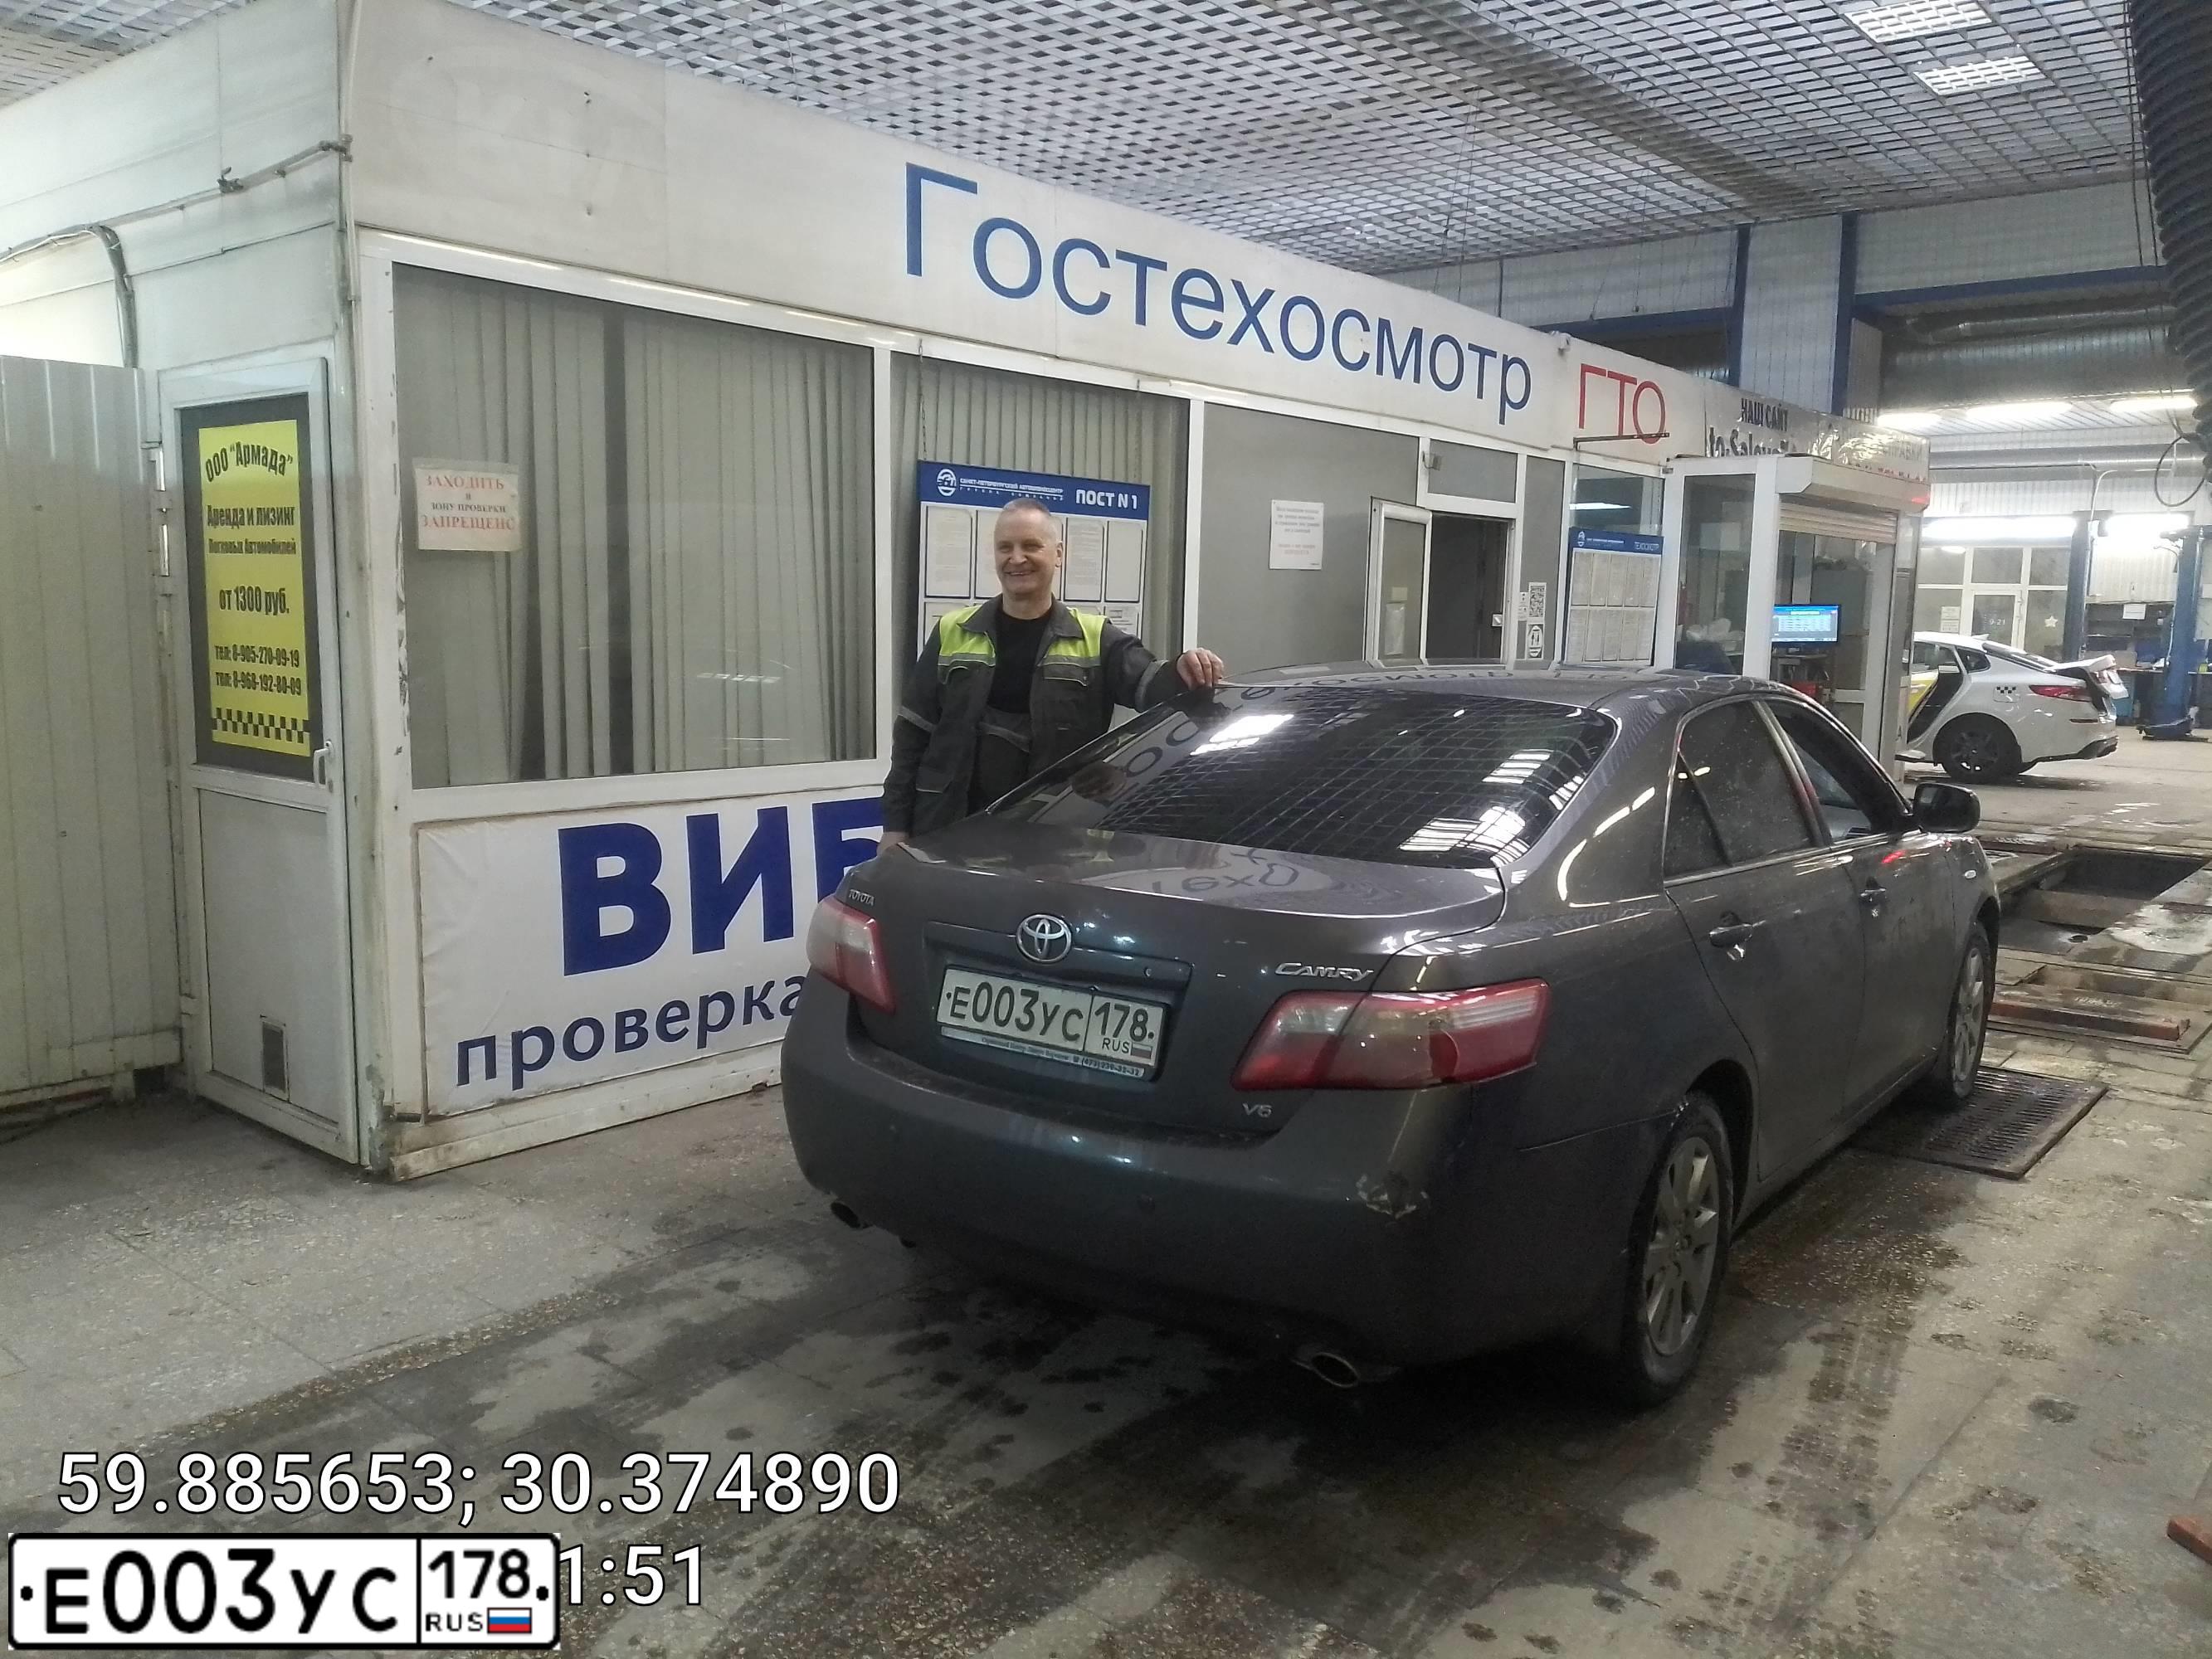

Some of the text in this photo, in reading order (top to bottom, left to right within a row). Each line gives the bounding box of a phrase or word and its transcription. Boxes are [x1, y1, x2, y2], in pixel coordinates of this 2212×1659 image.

[905, 163, 1532, 426] Гостехосмотр
[1578, 363, 1666, 445] ГТО
[1741, 398, 1764, 427] НАШ
[206, 447, 228, 482] ООО
[426, 475, 504, 489] ЗАХОДИТЬ
[1076, 489, 1114, 507] ПОСТ
[1131, 494, 1138, 509] 1
[207, 504, 295, 529] Аренда и лизинг
[219, 586, 290, 615] от 1300 руб.
[850, 888, 875, 906] TOYOTA
[457, 976, 805, 1091] проверка
[1094, 1002, 1149, 1043] 178
[1102, 1038, 1129, 1054] RUS
[1243, 1103, 1272, 1118] V6
